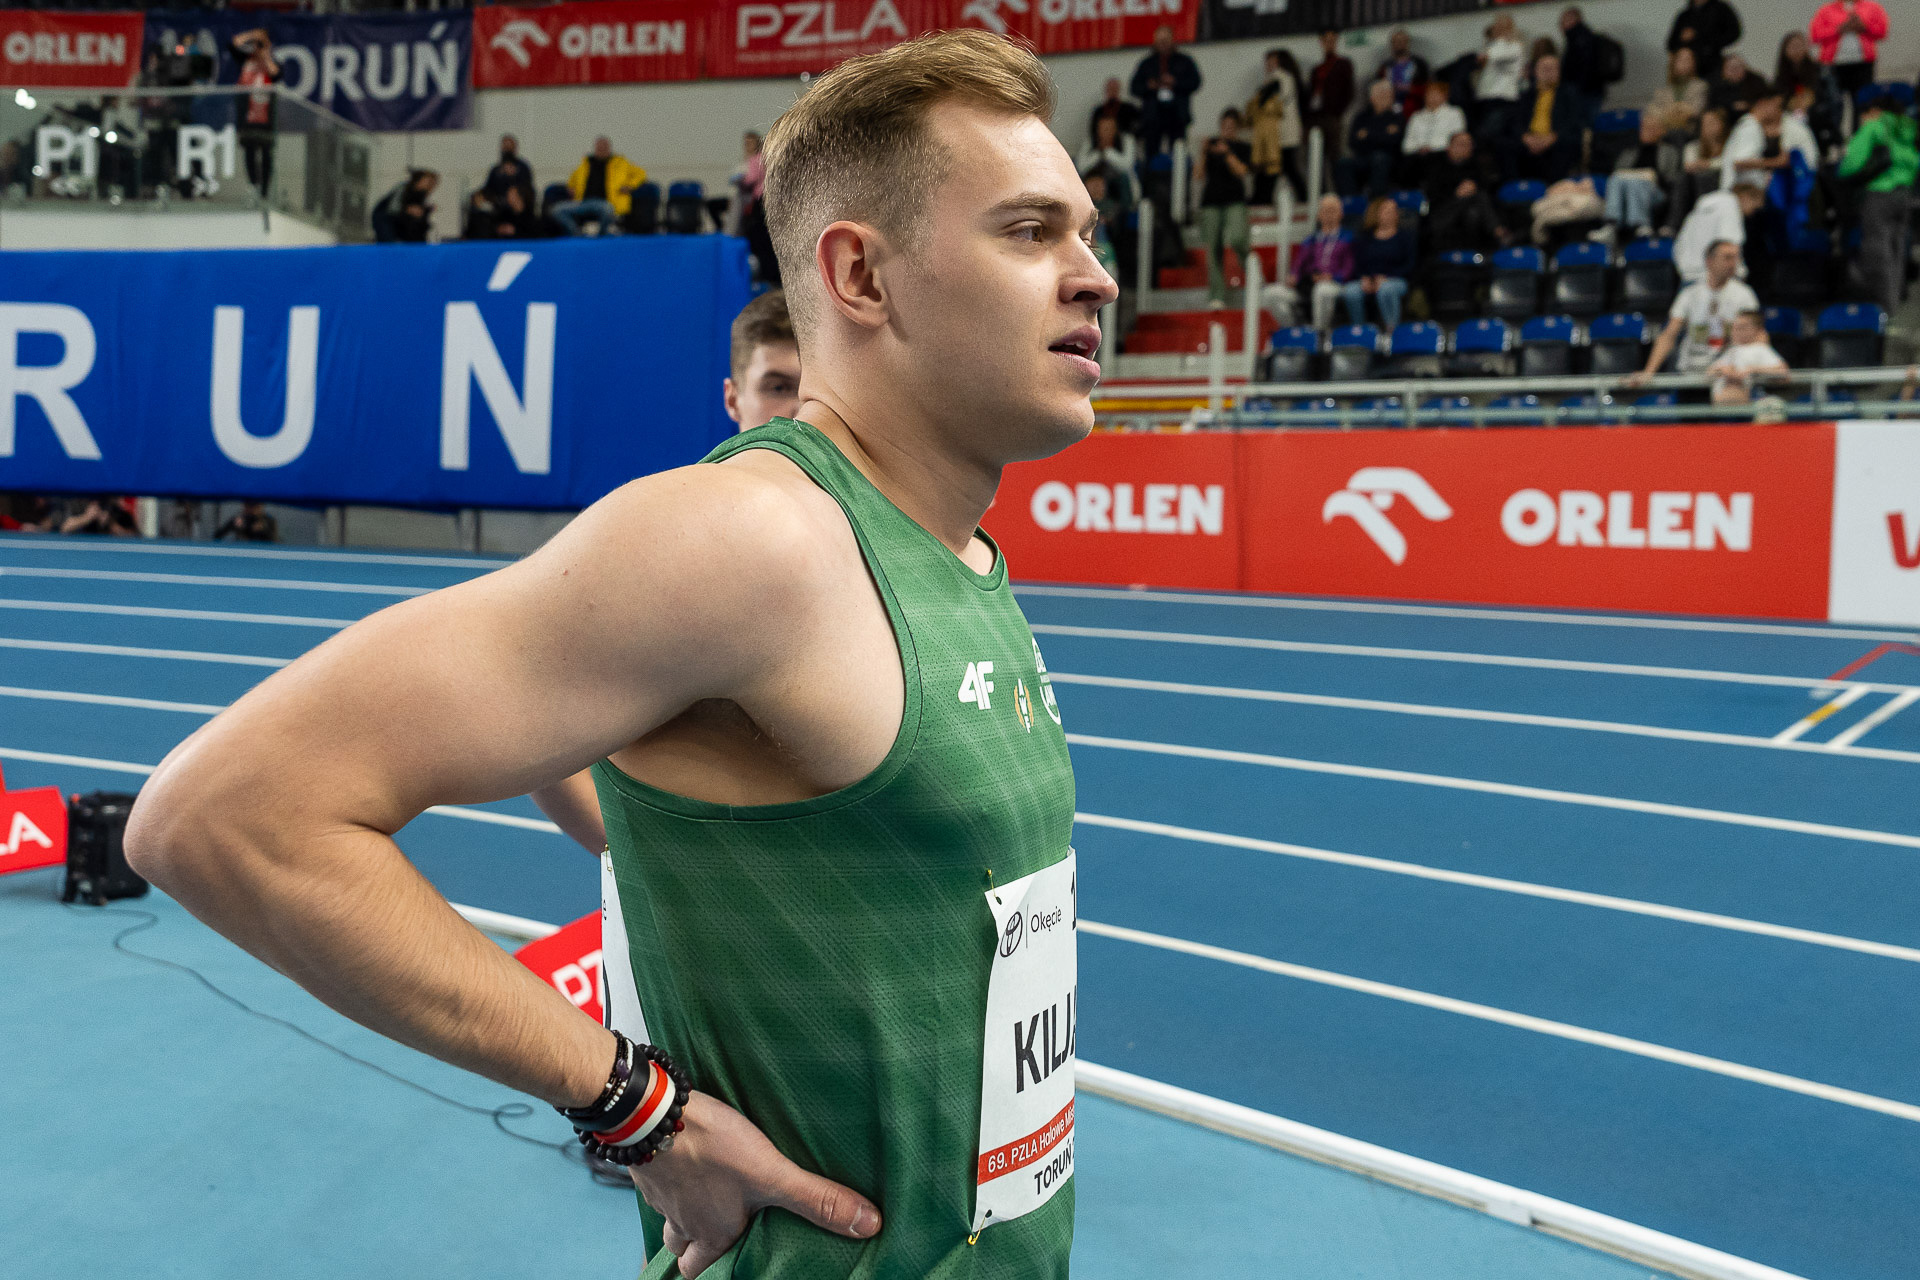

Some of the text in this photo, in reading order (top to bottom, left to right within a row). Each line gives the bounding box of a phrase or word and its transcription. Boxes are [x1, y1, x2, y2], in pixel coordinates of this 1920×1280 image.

[4, 31, 127, 66] ORLEN
[559, 20, 686, 58] ORLEN
[736, 0, 908, 49] PZLA
[273, 20, 459, 101] ORUŃ
[37, 125, 99, 178] P1
[177, 124, 236, 179] R1
[1030, 480, 1224, 536] ORLEN
[1501, 488, 1753, 552] ORLEN
[958, 660, 995, 711] 4F
[1030, 905, 1062, 933] Okęcie
[987, 1151, 1009, 1174] 69.
[1011, 1138, 1039, 1165] PZLA
[1039, 1118, 1065, 1151] Halowe
[1033, 1137, 1073, 1196] TORUŃ
